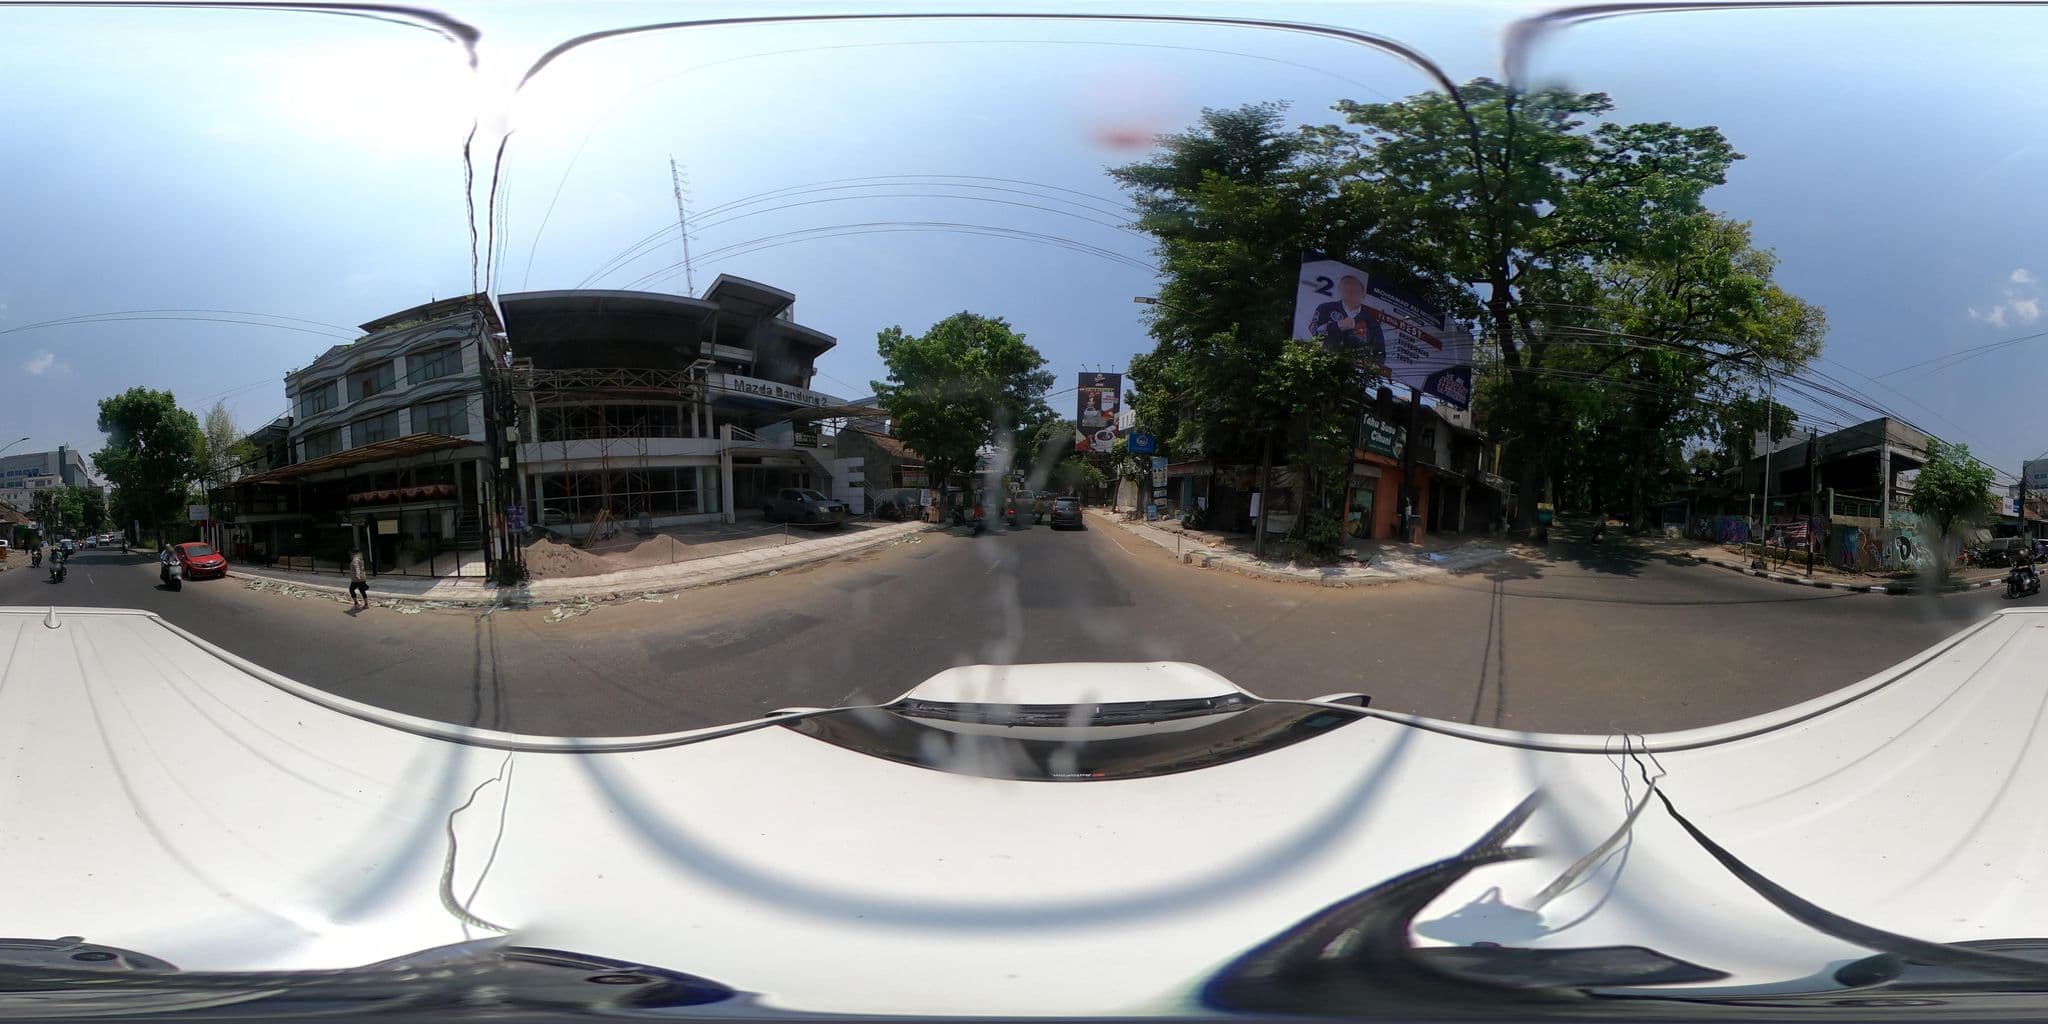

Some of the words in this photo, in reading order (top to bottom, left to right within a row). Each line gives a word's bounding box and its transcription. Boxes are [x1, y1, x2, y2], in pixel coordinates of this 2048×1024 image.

[1315, 276, 1334, 297] 2
[734, 379, 772, 395] Mazda
[775, 386, 820, 407] Bandung
